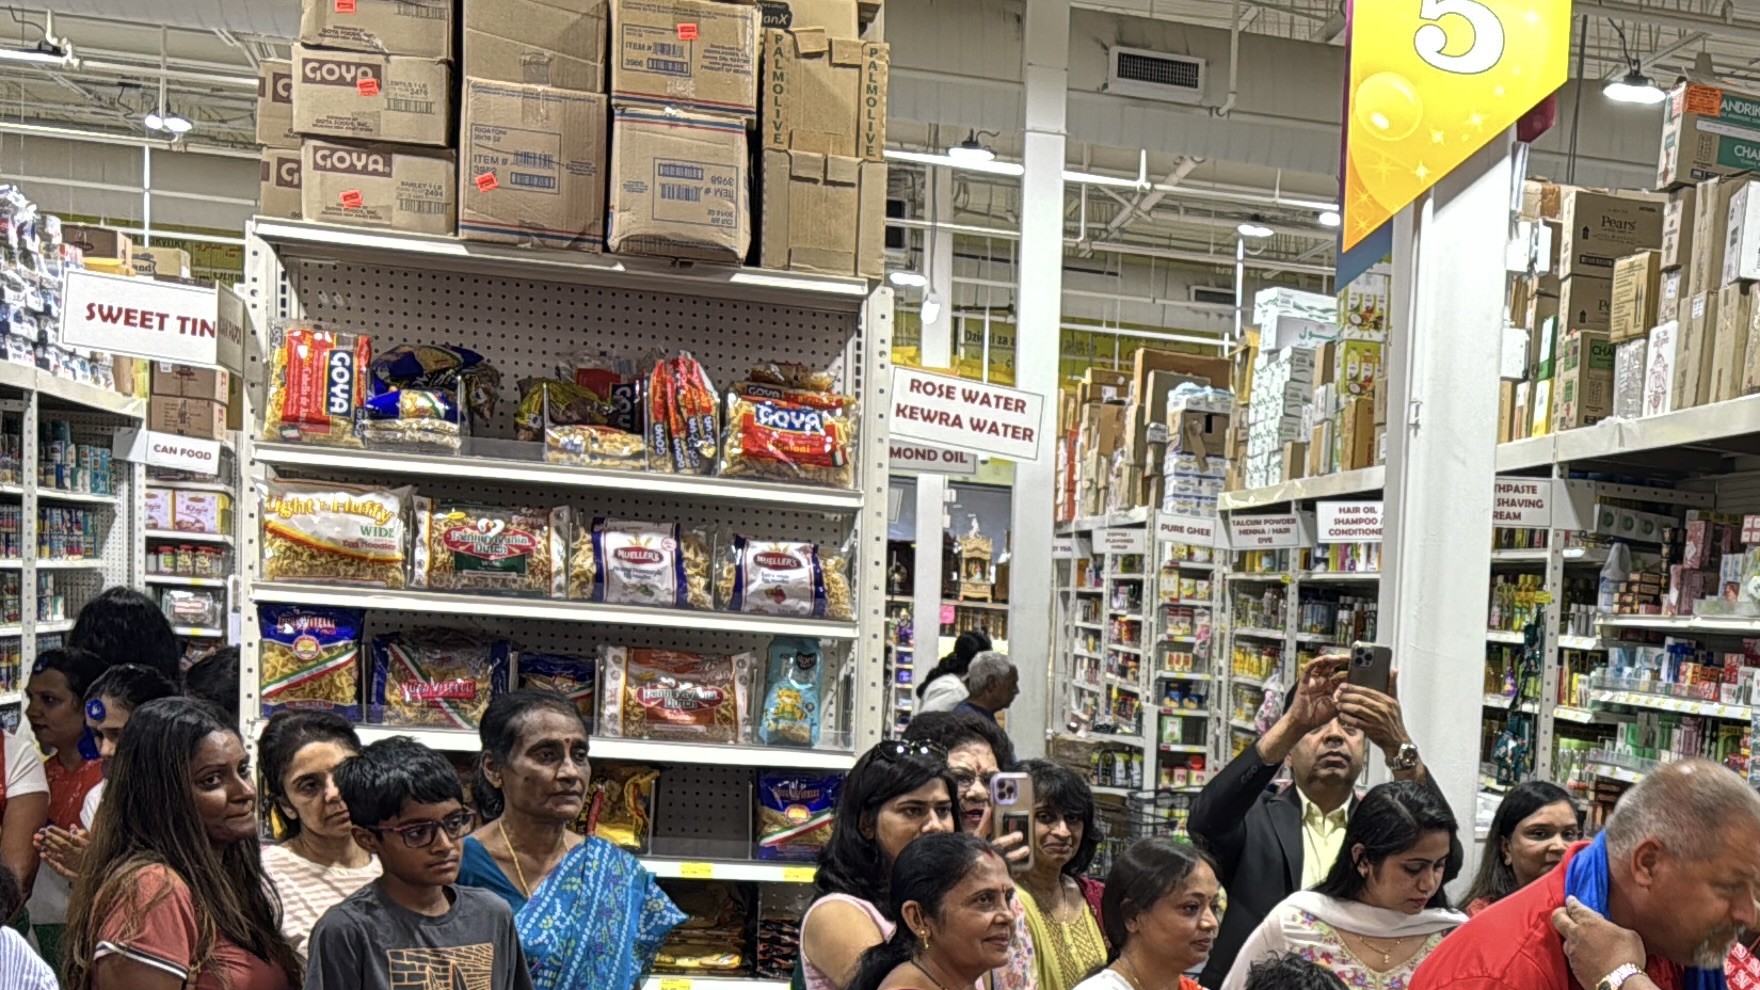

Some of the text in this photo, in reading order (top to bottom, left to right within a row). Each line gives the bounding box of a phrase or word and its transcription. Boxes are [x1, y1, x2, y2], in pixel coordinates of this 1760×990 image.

[1413, 0, 1505, 74] 5
[304, 61, 374, 83] GOYA
[772, 33, 785, 145] PALMOLIVE
[865, 48, 878, 156] PALMOLIVE
[315, 151, 385, 172] GOYA
[474, 154, 499, 165] ITEM
[85, 302, 170, 332] SWEET
[176, 314, 216, 338] TIN
[330, 351, 351, 413] GOYA
[909, 378, 1027, 414] ROSE WATER
[757, 405, 823, 430] GOYA
[895, 402, 1034, 444] KEWRA WATER
[654, 424, 666, 456] GOYA
[153, 443, 212, 461] CAN FOOD
[889, 447, 968, 464] MOND OIL
[1494, 483, 1538, 495] THPASTE
[266, 495, 395, 525] Light Fluffy
[1338, 505, 1377, 515] HAIR OIL
[1496, 497, 1544, 509] SHAVING
[1263, 518, 1297, 527] POWDER
[1334, 517, 1378, 526] SHAMPOO
[1493, 510, 1522, 521] REAM
[360, 525, 395, 538] WIDE
[1160, 522, 1211, 537] PURE GHEE
[1238, 526, 1291, 536] HENNA HAIR
[1328, 527, 1384, 537] CONDITIONE
[616, 549, 660, 562] MUELLER'S
[756, 555, 799, 567] MUELLER'S
